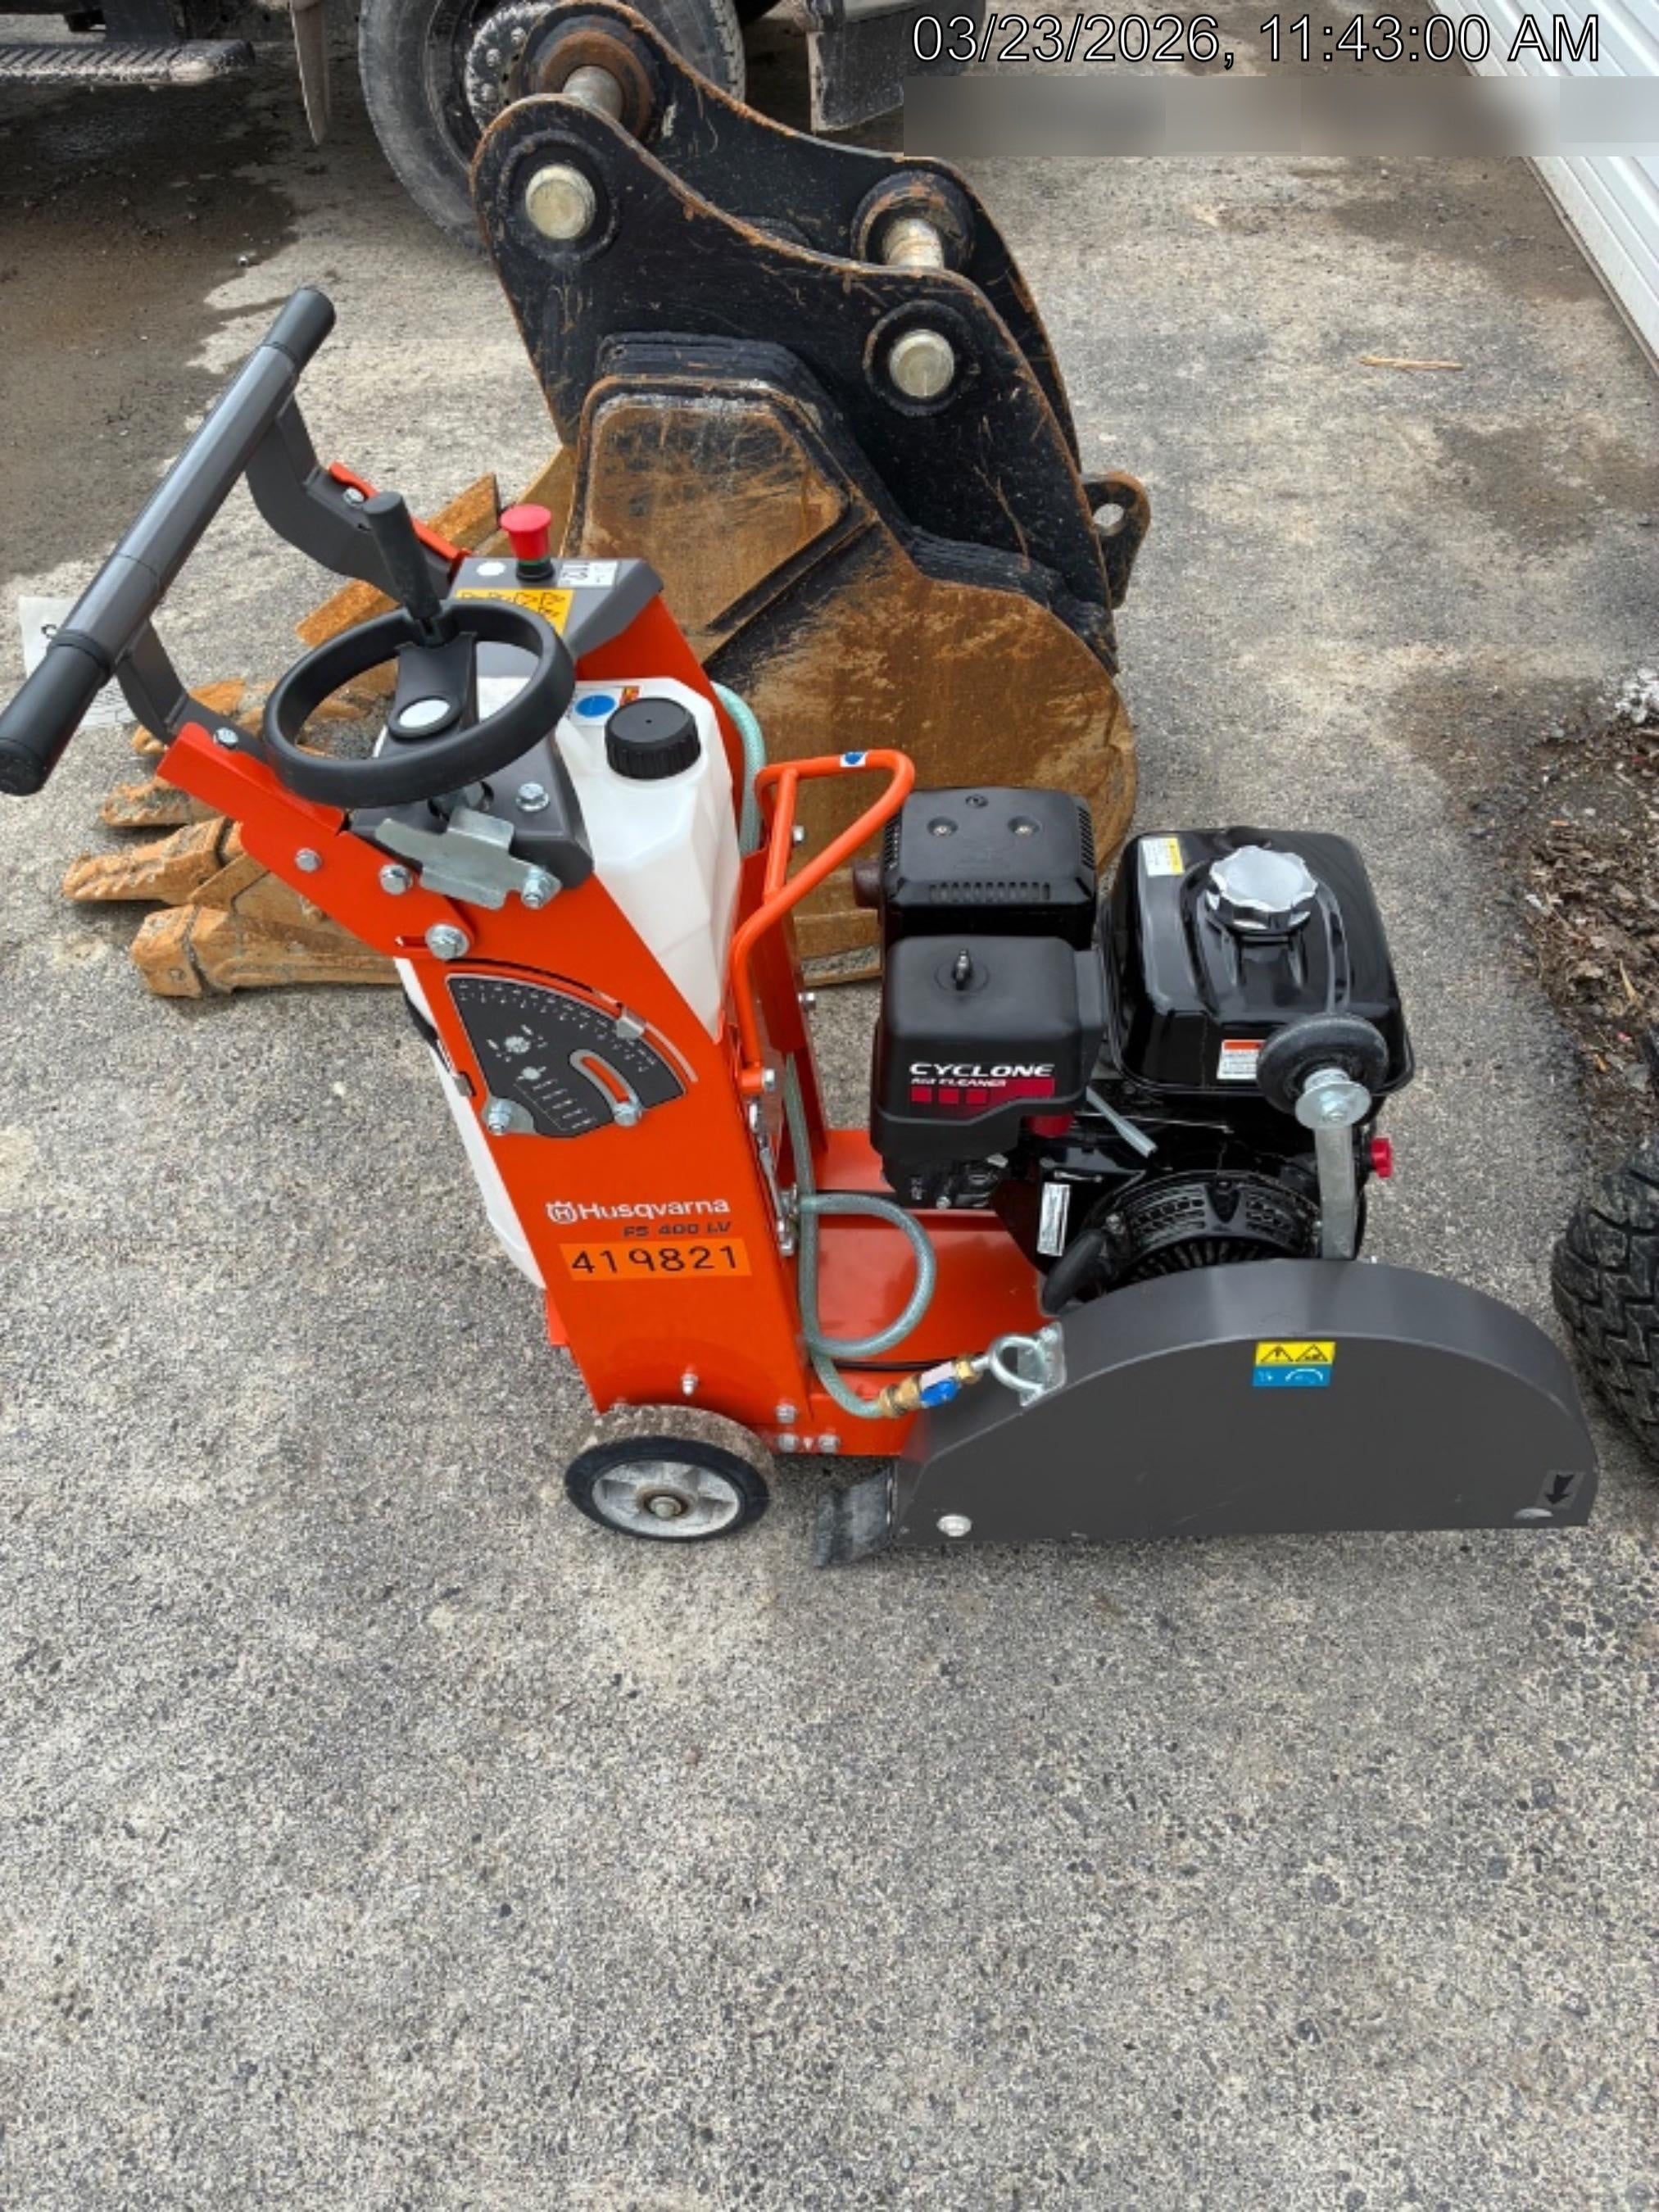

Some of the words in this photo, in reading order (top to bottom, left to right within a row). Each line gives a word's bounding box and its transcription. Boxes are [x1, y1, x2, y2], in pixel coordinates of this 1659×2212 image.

[909, 1062, 1056, 1078] CYCLONE
[939, 1077, 1008, 1088] CLEANER
[577, 1199, 731, 1220] Husqvarna
[623, 1225, 650, 1238] FS
[706, 1221, 732, 1234] LV
[571, 1244, 737, 1274] 419821
